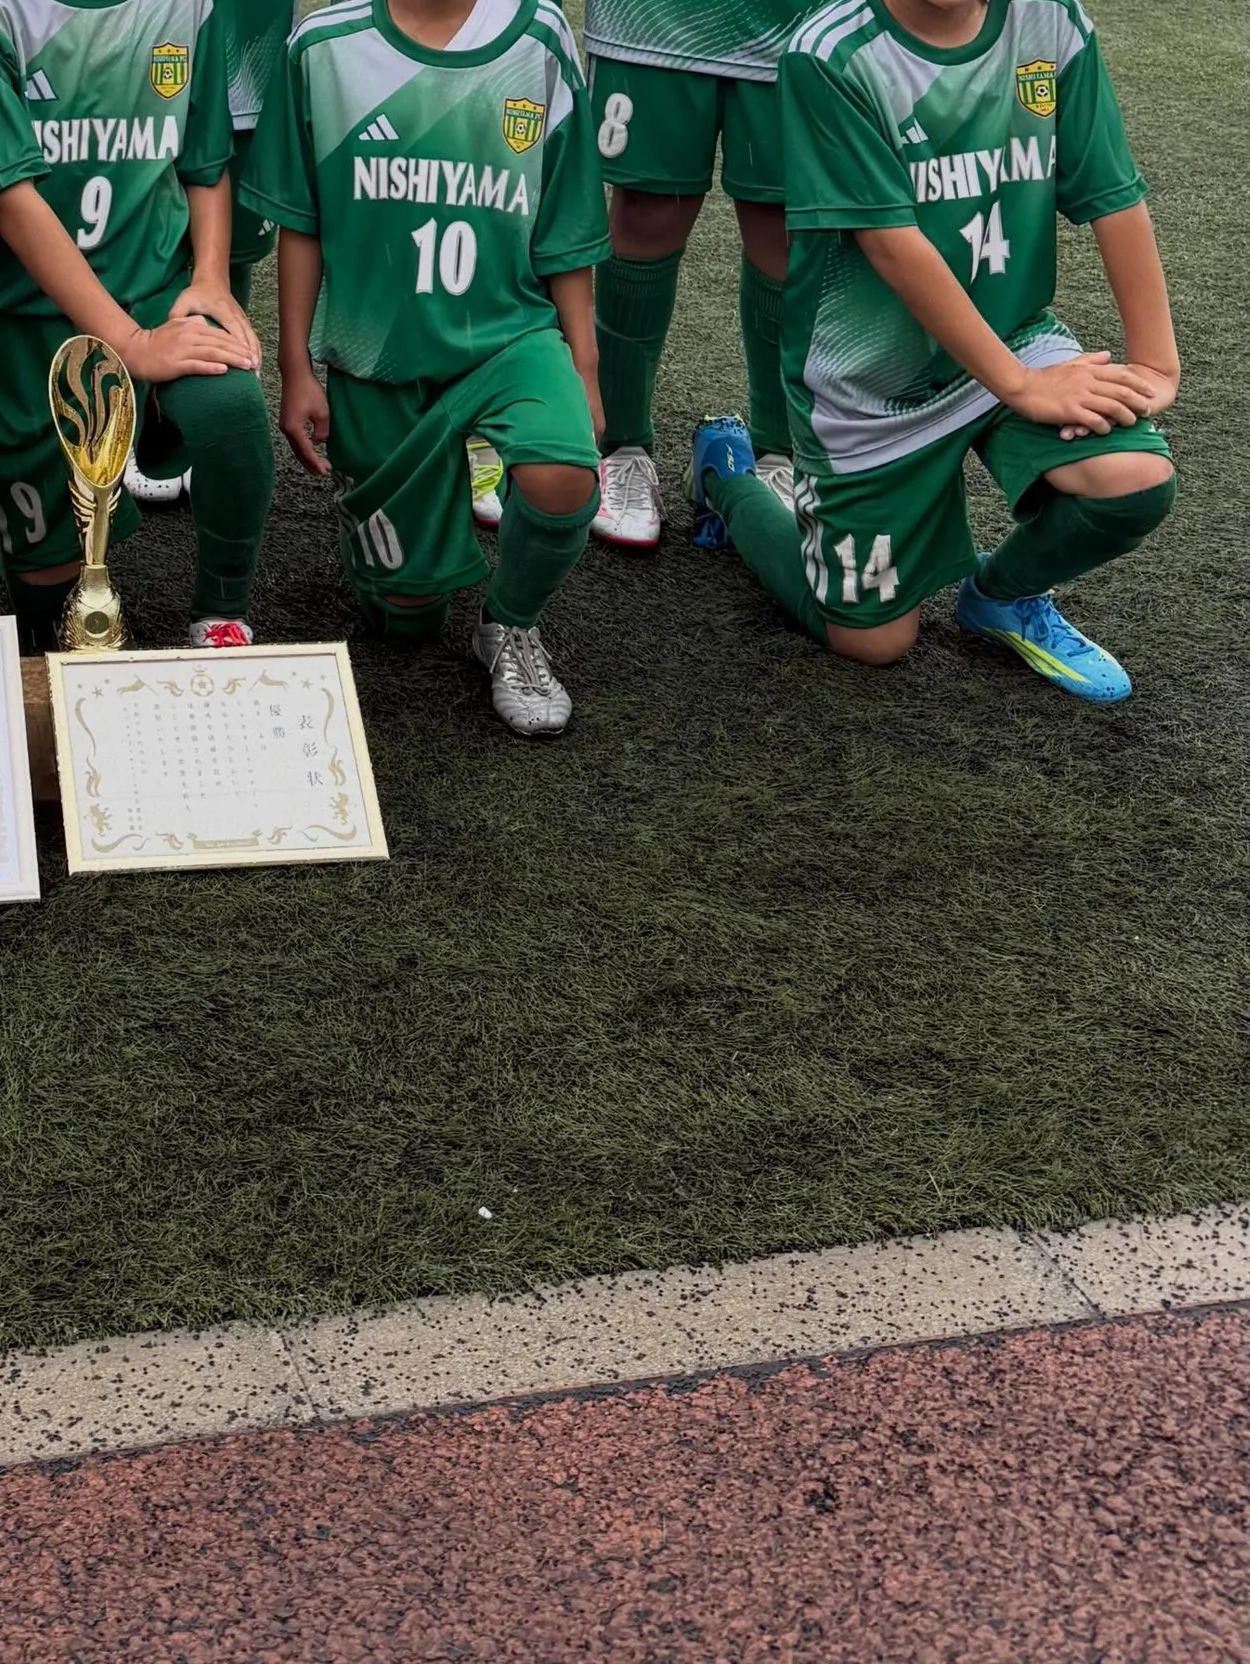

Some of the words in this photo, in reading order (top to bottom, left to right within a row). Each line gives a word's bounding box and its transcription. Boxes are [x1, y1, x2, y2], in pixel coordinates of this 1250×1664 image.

[597, 92, 634, 159] 8
[76, 175, 113, 250] 9
[353, 155, 529, 216] NISHIYAMA
[411, 218, 478, 296] 10
[958, 199, 1011, 286] 14
[10, 482, 47, 544] 9
[832, 533, 900, 605] 14
[300, 715, 324, 786] 表彰状
